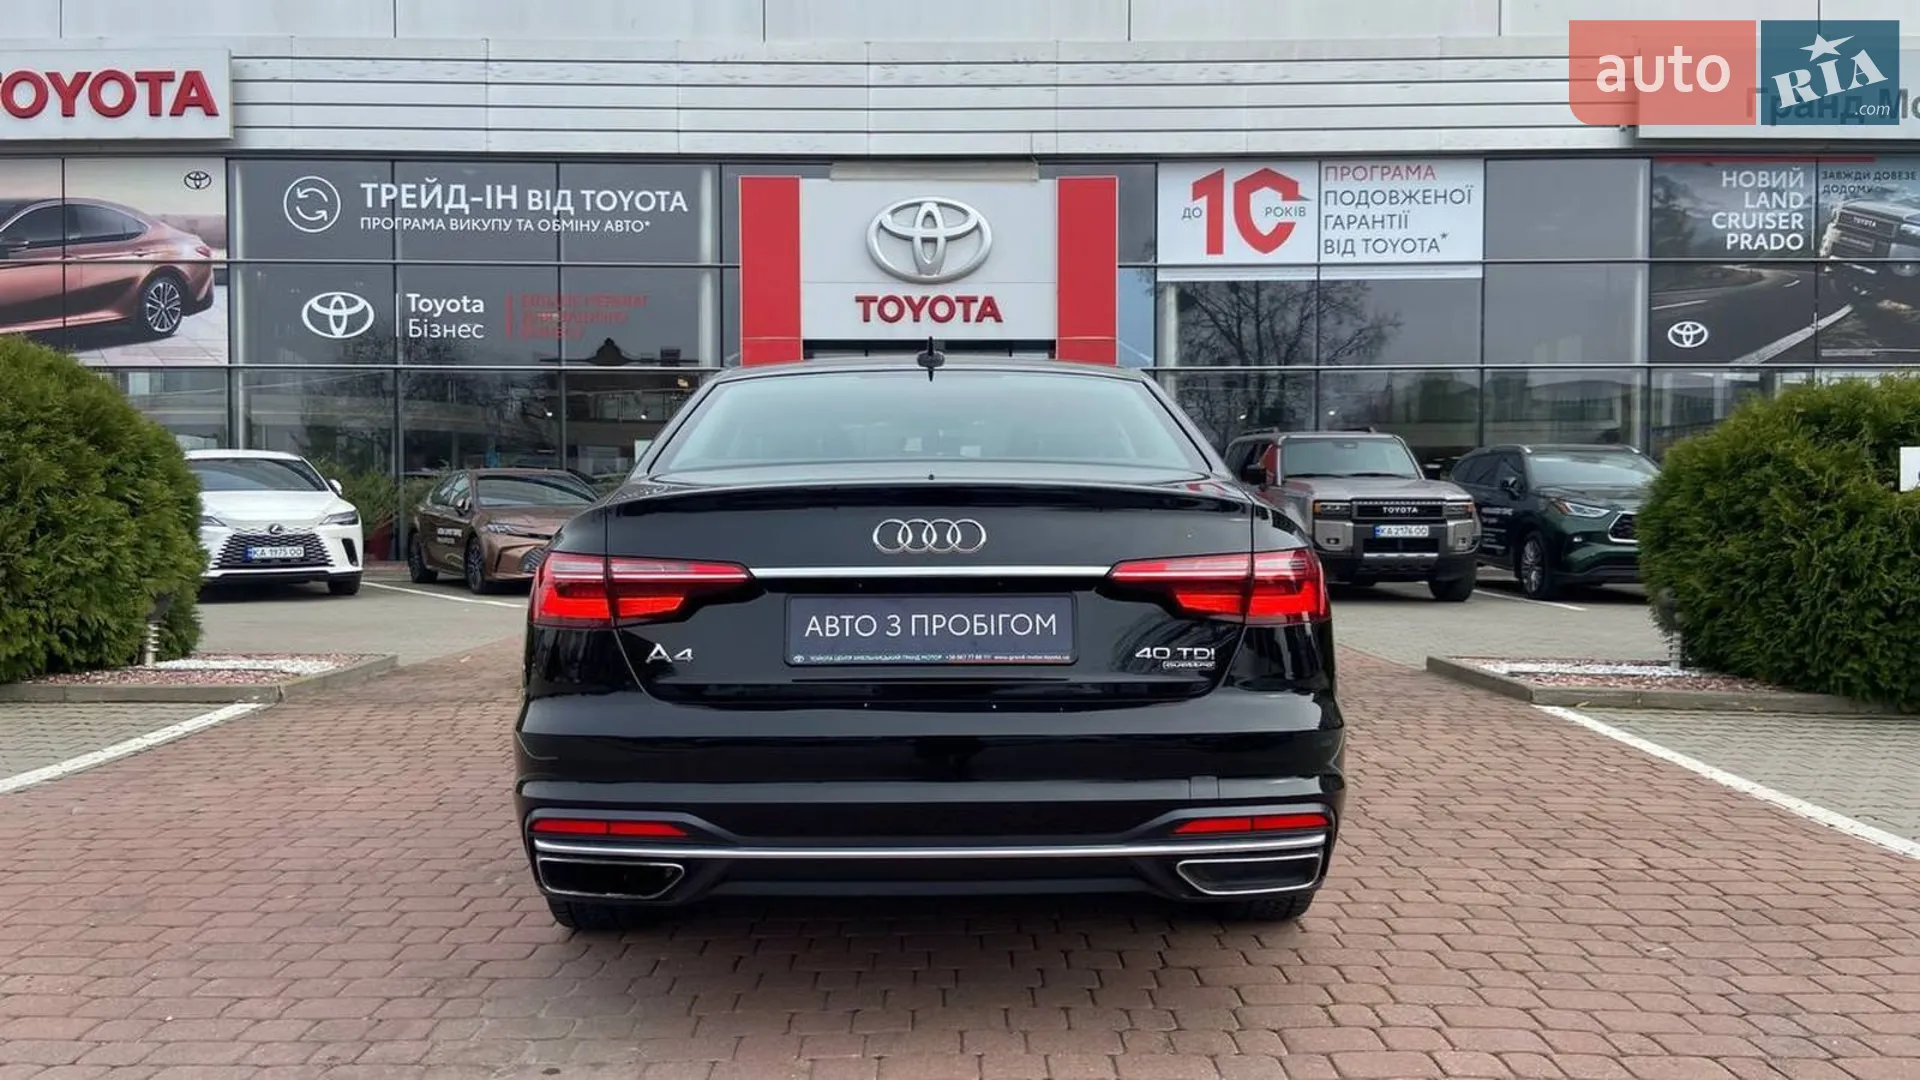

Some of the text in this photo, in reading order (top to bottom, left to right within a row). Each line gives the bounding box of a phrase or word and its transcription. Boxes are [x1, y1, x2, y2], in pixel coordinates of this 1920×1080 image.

[0, 69, 220, 119] OYOTA
[1324, 165, 1437, 182] ПРОГРАМА
[1722, 167, 1804, 188] НОВИЙ
[1822, 170, 1917, 181] ЗАВЖДИ ДОВЕЗЕ
[360, 177, 689, 216] ТРЕЙД-ІН ВІД TOYOTA
[1324, 184, 1475, 209] ПОДОВЖЕНОЇ
[1822, 184, 1873, 195] ДОДОМУ
[1744, 191, 1804, 209] LAND
[1182, 207, 1203, 220] ДО
[1264, 206, 1307, 218] РОКІВ
[1324, 210, 1411, 230] ГАРАНТІЇ
[1712, 211, 1804, 229] CRUISER
[360, 217, 446, 231] ПРОГРАМА
[450, 218, 513, 232] ВИКУПУ
[516, 218, 534, 231] ТА
[538, 219, 601, 233] ОБМІНУ
[1324, 237, 1356, 257] ВІД
[1726, 233, 1804, 251] PRADO
[406, 293, 485, 317] Toyota
[855, 294, 1004, 324] TOYOTA
[408, 318, 485, 339] Бізнес
[1382, 506, 1419, 515] TOYOTA
[804, 613, 1057, 637] АВТО З ПРОБІГОМ
[645, 643, 694, 663] A4
[1135, 647, 1216, 660] 40 TDI
